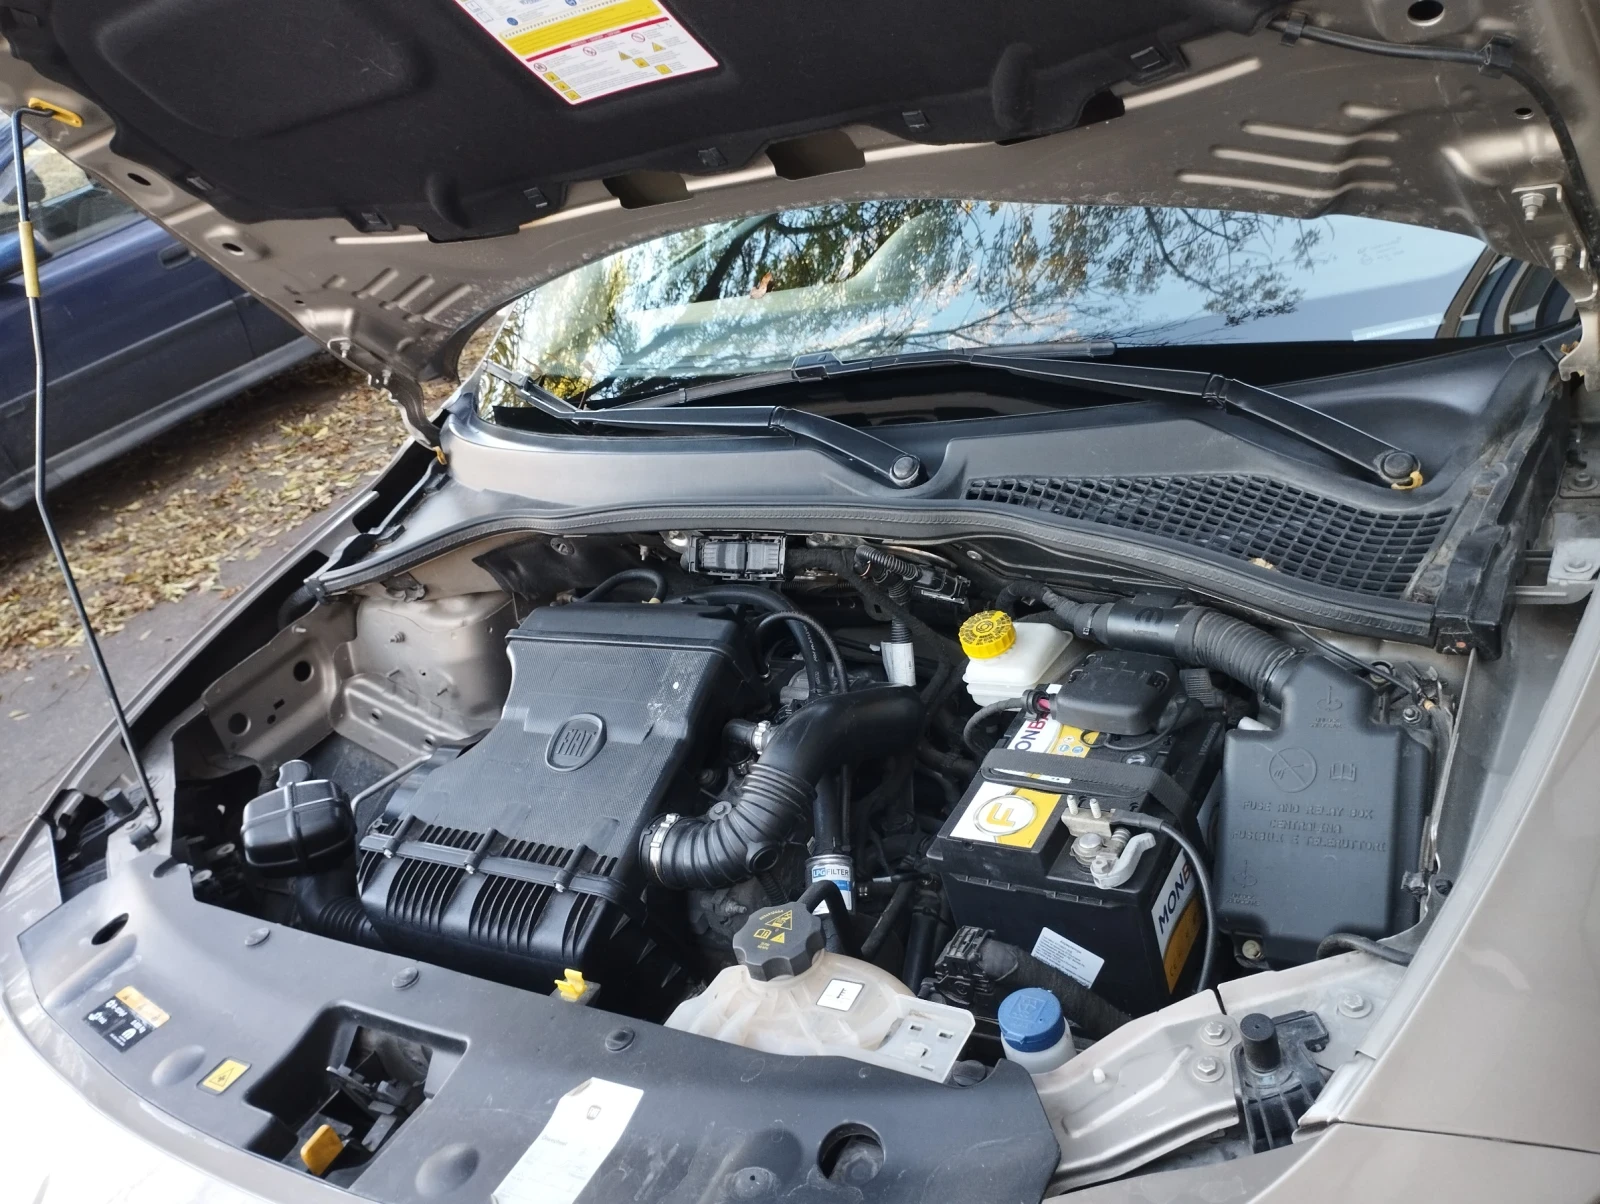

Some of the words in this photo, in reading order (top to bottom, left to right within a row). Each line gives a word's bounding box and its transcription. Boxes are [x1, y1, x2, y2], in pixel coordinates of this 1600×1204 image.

[555, 728, 597, 758] FIAT
[1242, 801, 1272, 812] FUSE
[1277, 802, 1300, 814] AND
[1306, 805, 1345, 817] RELAY
[1349, 808, 1375, 820] BOX
[1269, 819, 1343, 834] CENTRALINA
[1291, 835, 1300, 845] E
[1306, 836, 1387, 852] TELERUTTORI
[813, 869, 826, 878] LPG
[826, 868, 849, 876] FILTER
